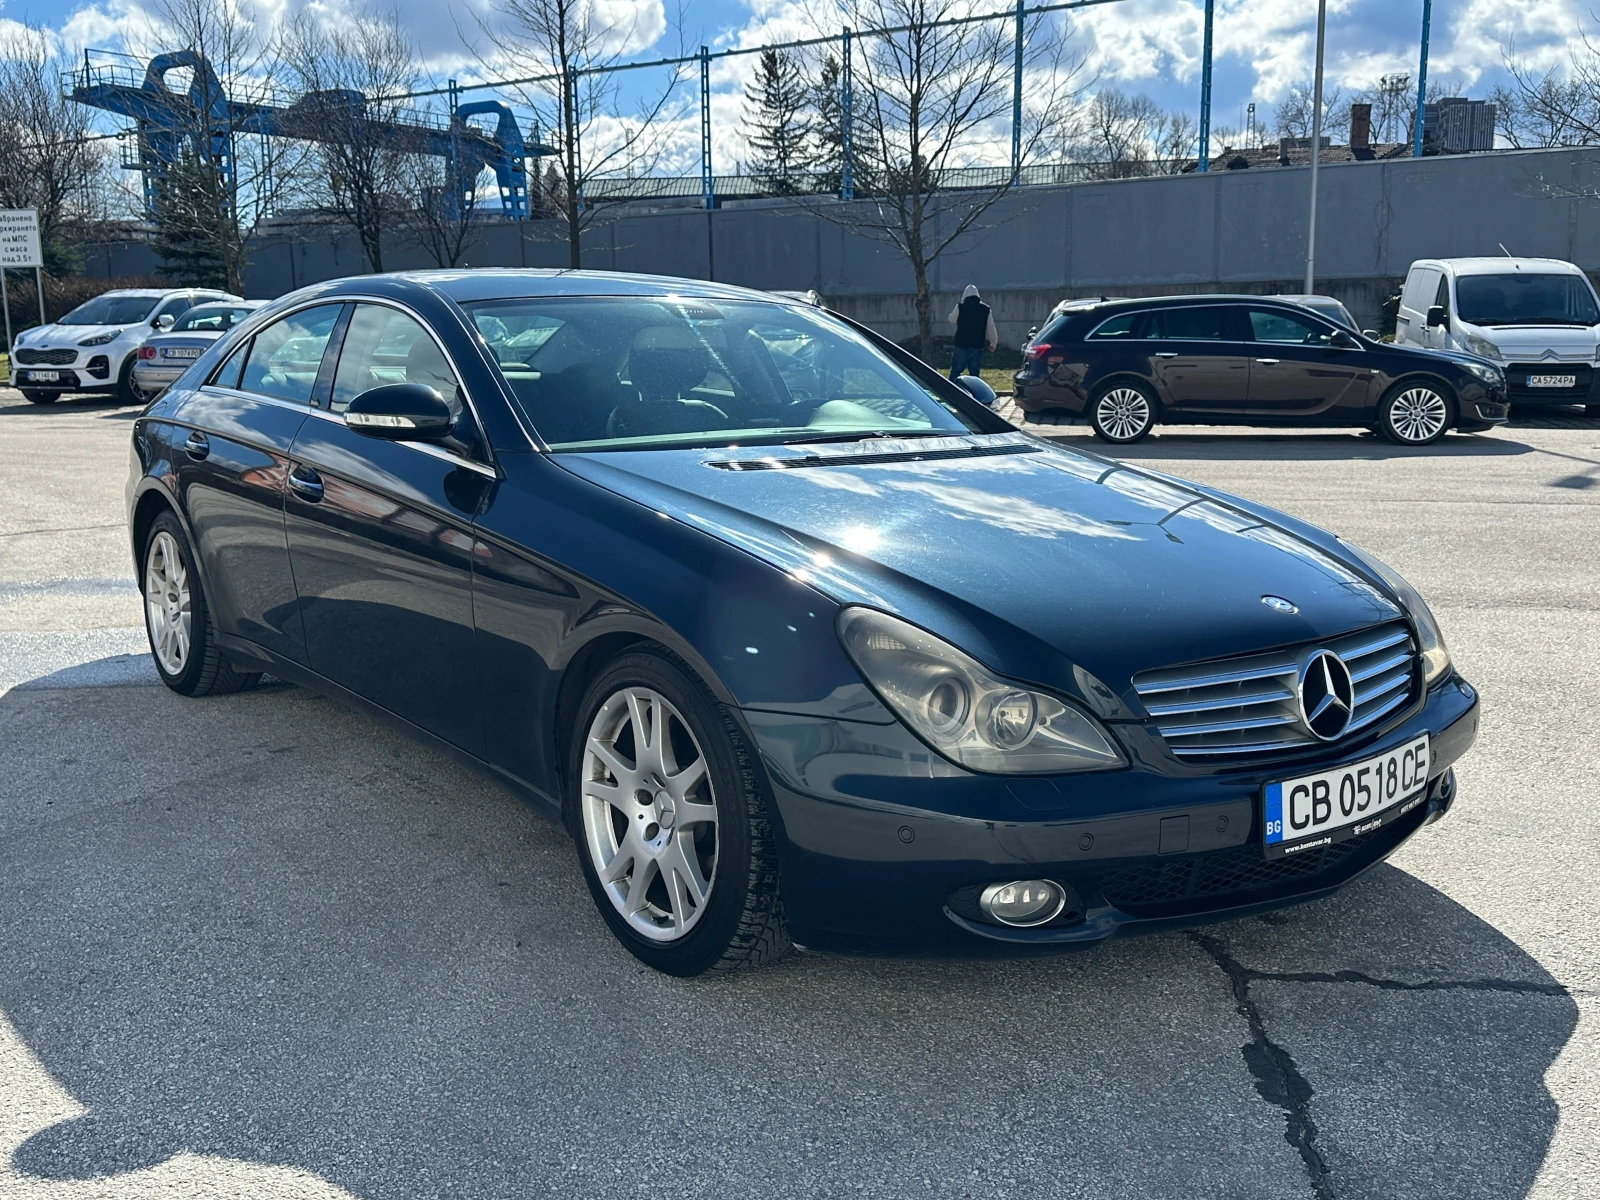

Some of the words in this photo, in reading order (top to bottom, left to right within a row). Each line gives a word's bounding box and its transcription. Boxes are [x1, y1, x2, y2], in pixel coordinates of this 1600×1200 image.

[12, 234, 28, 243] МПС
[1531, 376, 1542, 385] CA
[1543, 376, 1562, 385] 5724
[1563, 376, 1574, 385] PA
[1289, 779, 1332, 830] CB
[1339, 757, 1398, 817] 0518
[1401, 742, 1427, 792] CE
[1266, 820, 1281, 835] BG
[1284, 836, 1332, 854] www.kentavar.bg
